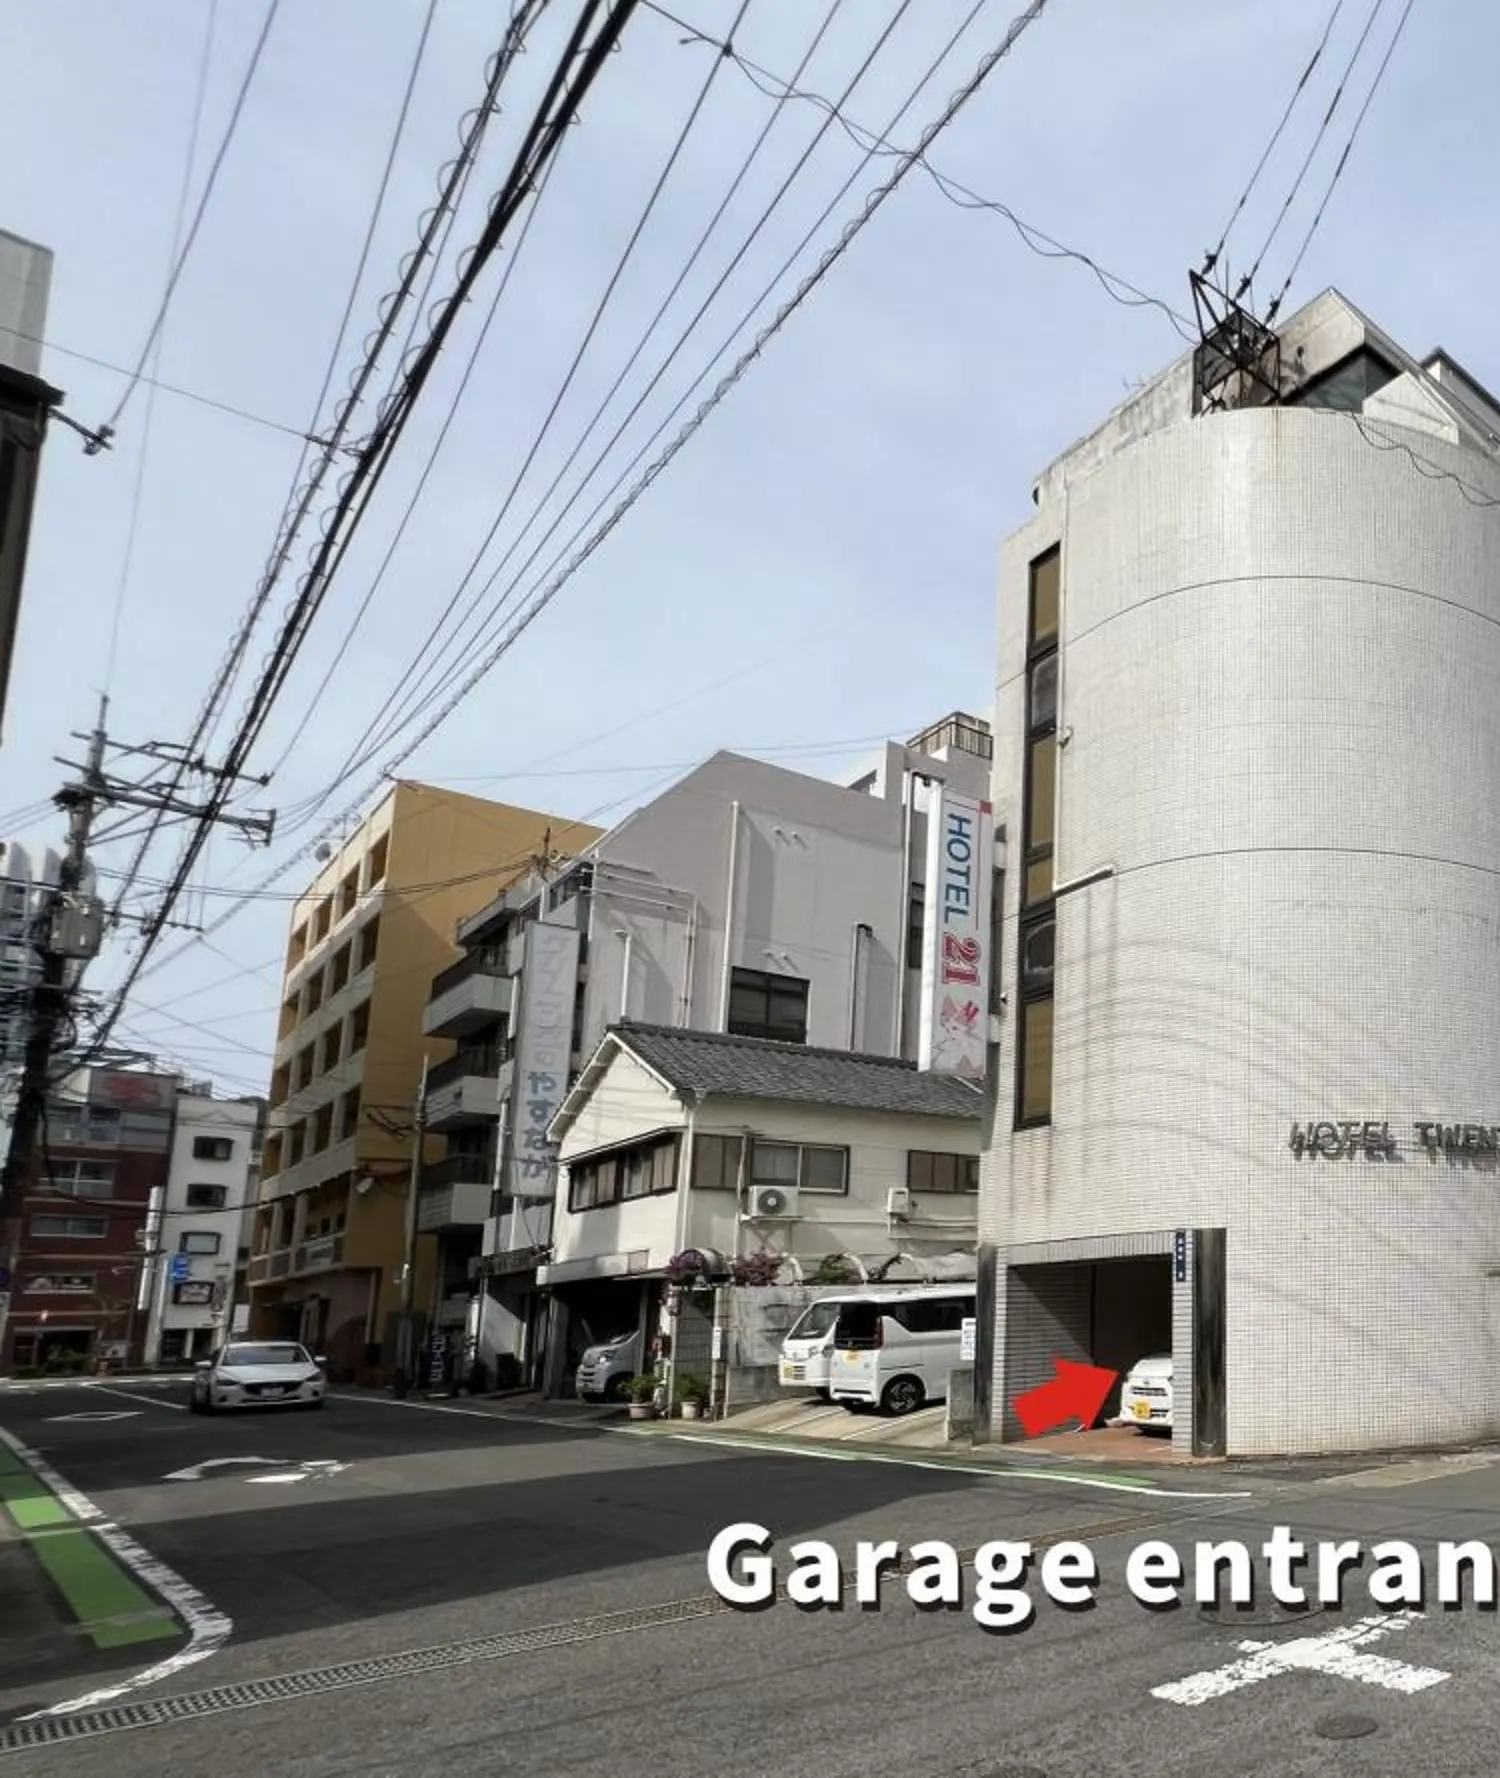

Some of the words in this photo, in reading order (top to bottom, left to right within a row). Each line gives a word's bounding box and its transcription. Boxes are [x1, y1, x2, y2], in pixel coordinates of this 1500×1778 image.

[946, 813, 972, 923] HOTEL
[942, 932, 981, 986] 21
[1290, 1121, 1396, 1153] HOTEL
